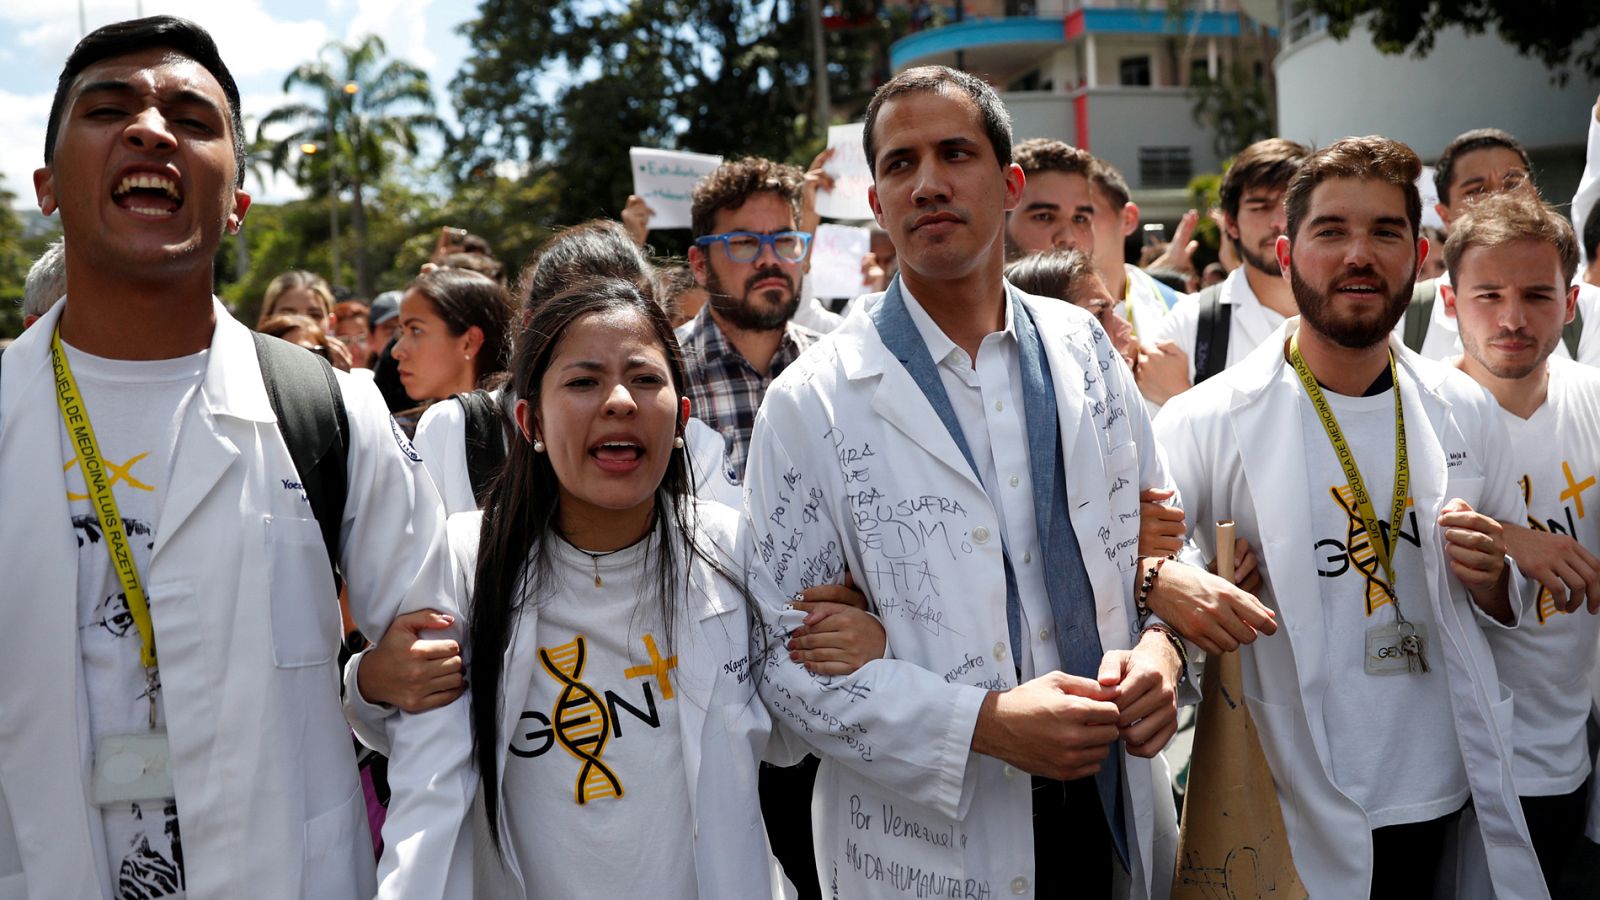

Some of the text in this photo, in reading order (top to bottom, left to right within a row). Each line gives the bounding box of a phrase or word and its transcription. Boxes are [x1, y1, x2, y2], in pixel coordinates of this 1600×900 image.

[1304, 376, 1320, 397] LUIS
[1315, 396, 1343, 443] MEDICINA
[1336, 444, 1350, 459] DE
[1397, 423, 1407, 472] MEDICINA
[51, 348, 138, 590] ESCUELA DE MEDICINA LUIS RAZETTI
[1344, 461, 1368, 504] ESCUELA
[1396, 475, 1406, 497] LUIS
[770, 491, 791, 529] por
[1366, 518, 1380, 539] UCV
[1392, 500, 1403, 542] RAZETTI
[849, 794, 968, 850] Por Venezuela
[887, 861, 992, 900] HUMANITARIA
